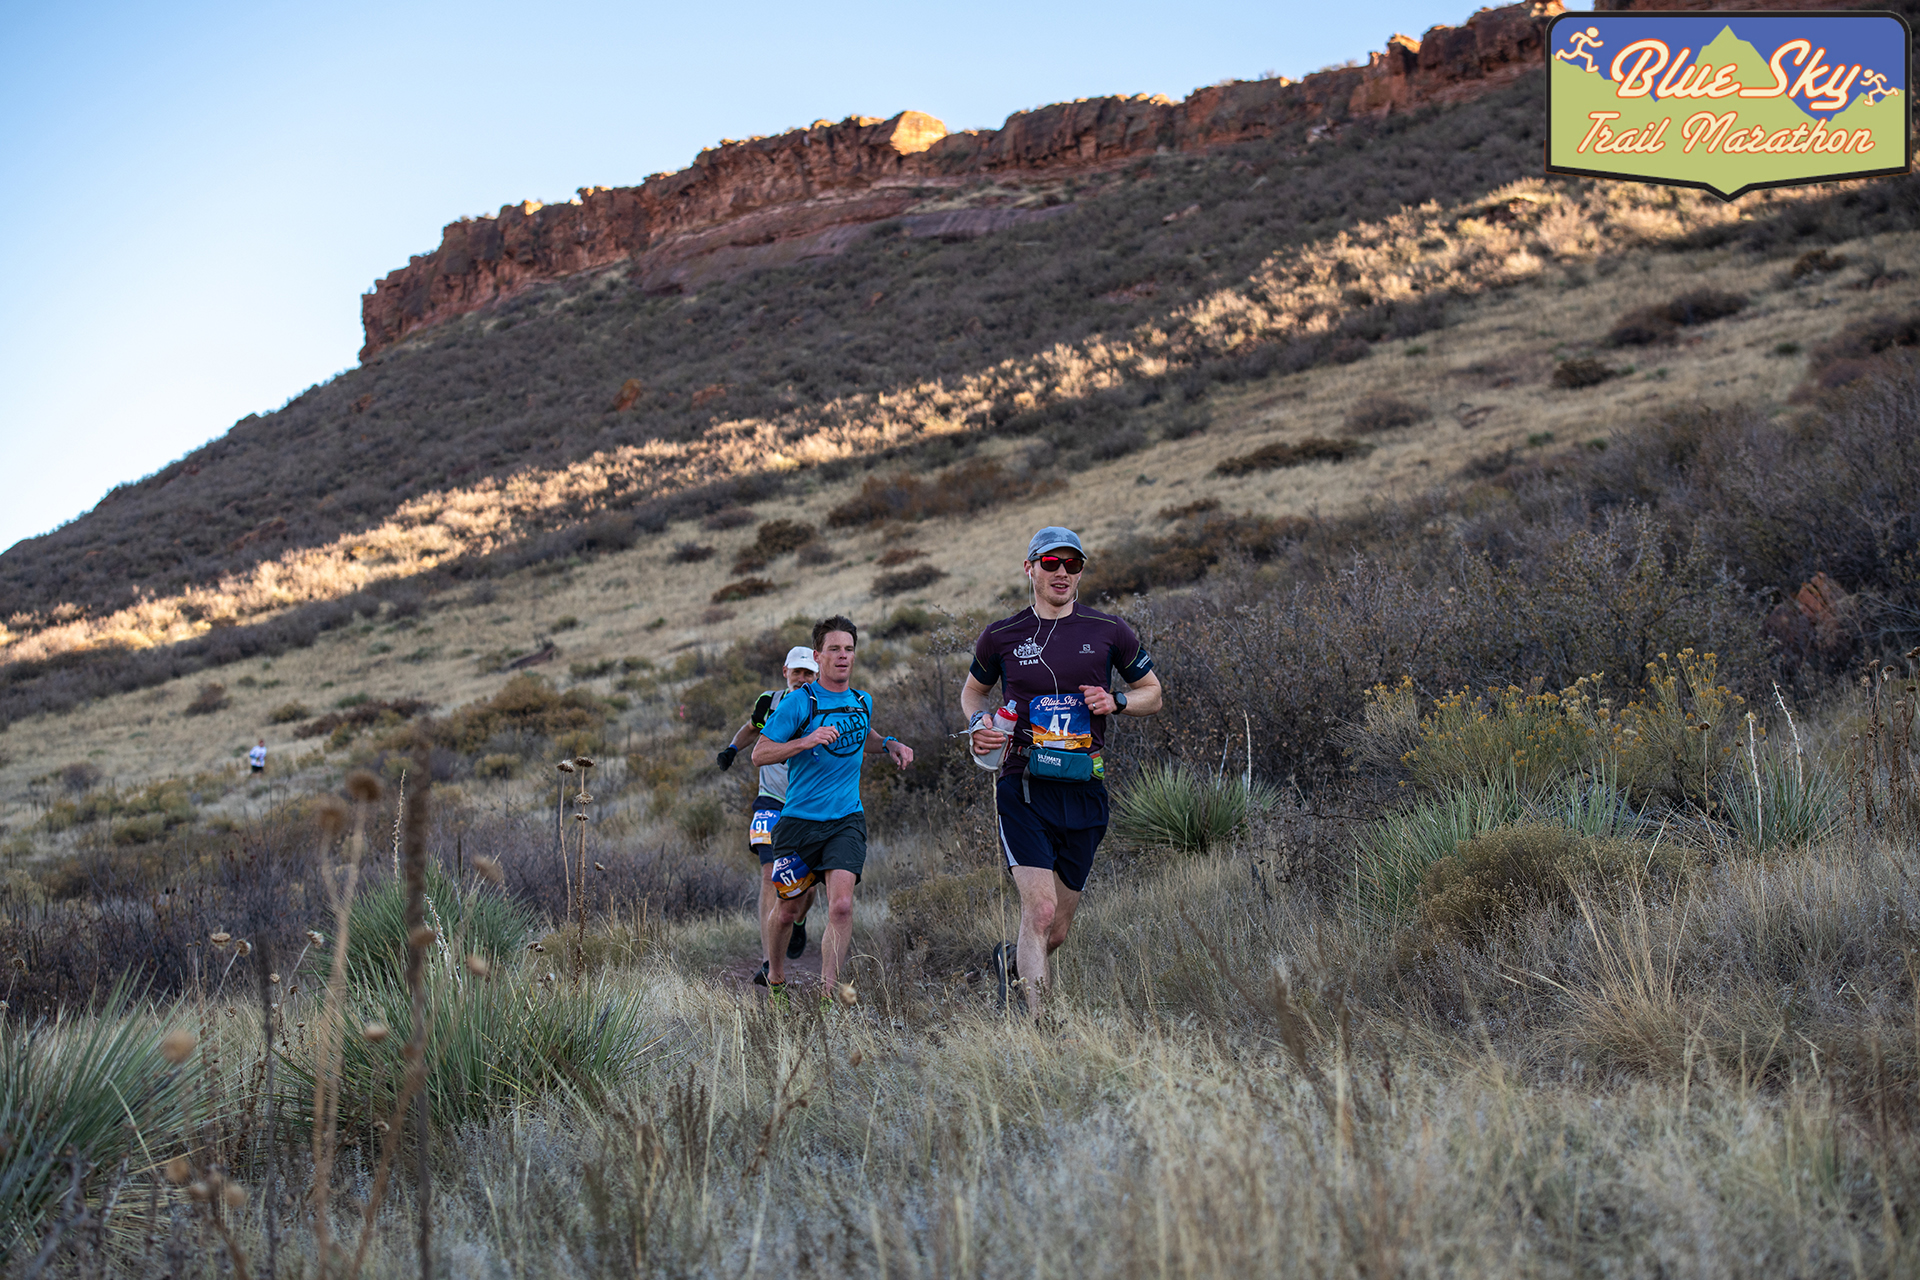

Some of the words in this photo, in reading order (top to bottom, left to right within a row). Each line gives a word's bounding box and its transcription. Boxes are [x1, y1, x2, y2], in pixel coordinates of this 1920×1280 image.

[1060, 695, 1078, 706] Sky
[1050, 713, 1071, 736] 47
[834, 732, 862, 751] 2016
[755, 820, 768, 834] 91
[779, 868, 798, 887] 67
